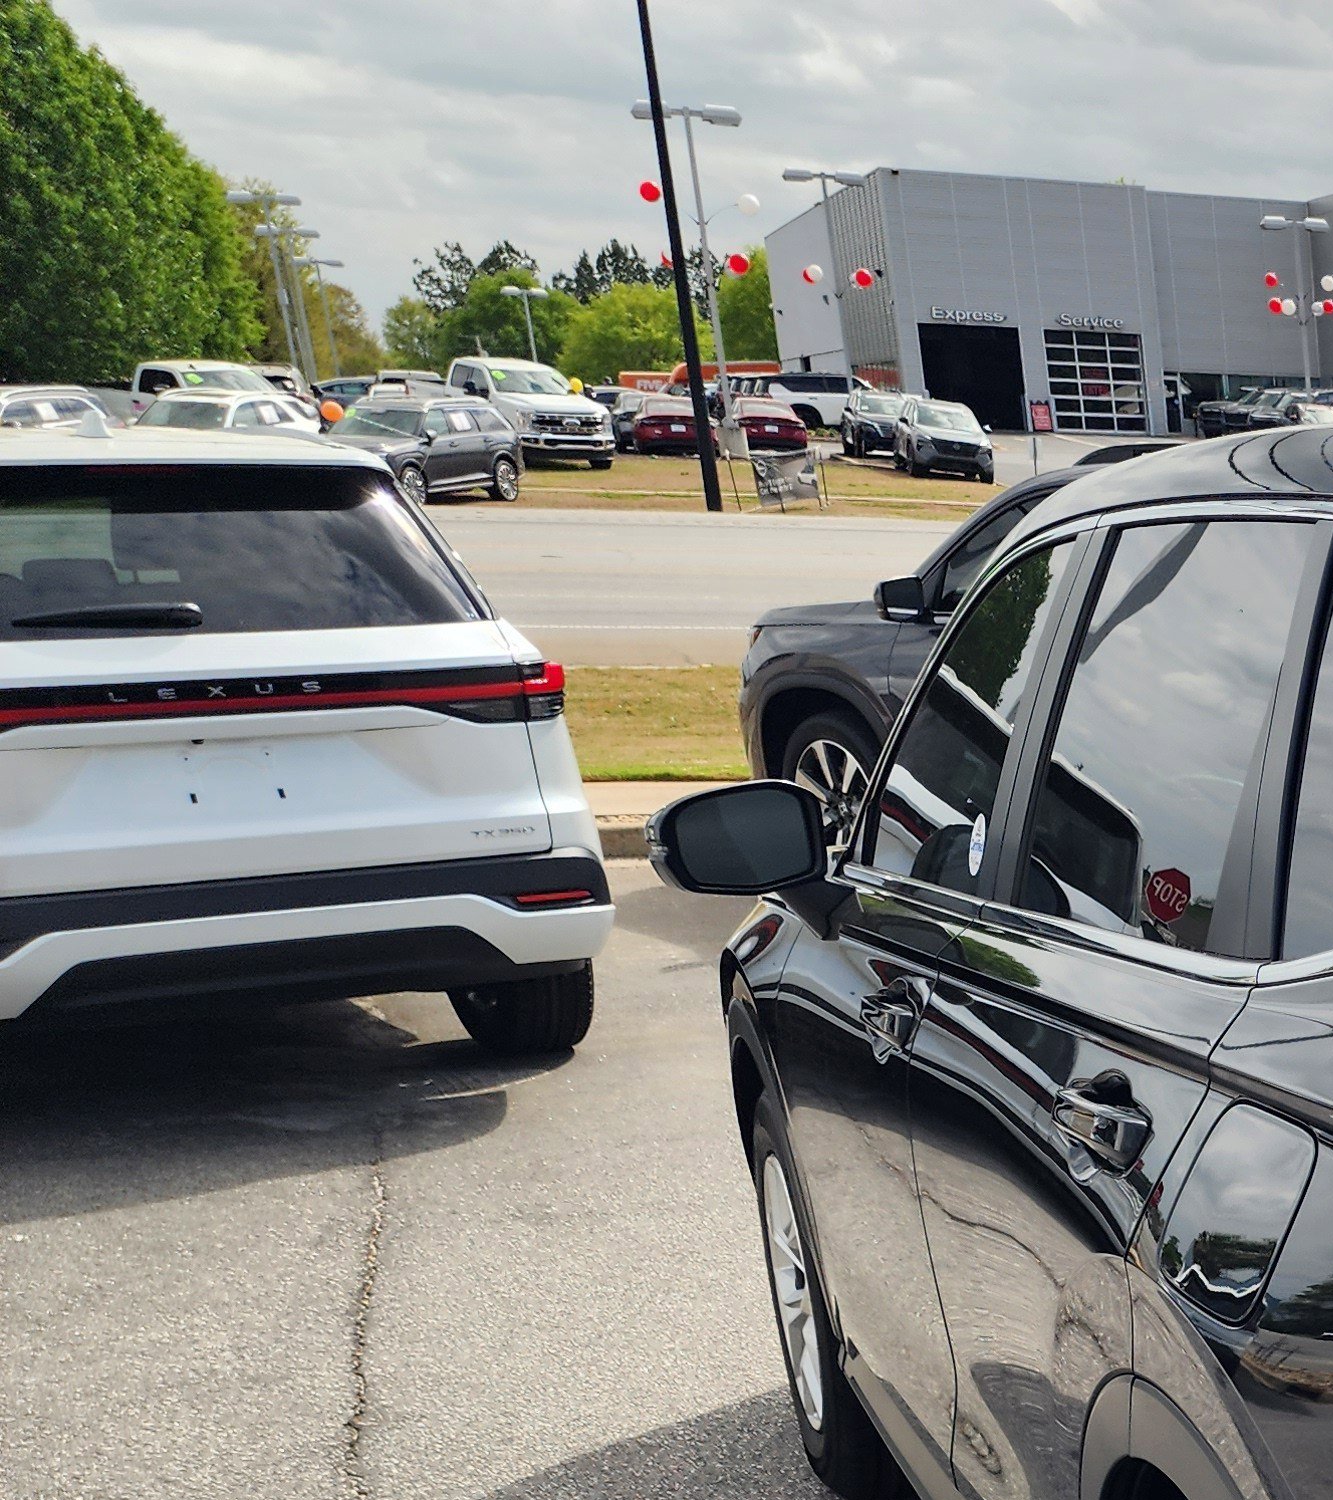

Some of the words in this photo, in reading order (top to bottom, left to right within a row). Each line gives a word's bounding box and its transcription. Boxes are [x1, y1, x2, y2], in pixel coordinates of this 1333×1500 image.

[930, 305, 1006, 324] Express
[1059, 313, 1124, 329] Service
[108, 681, 322, 703] LEXUS
